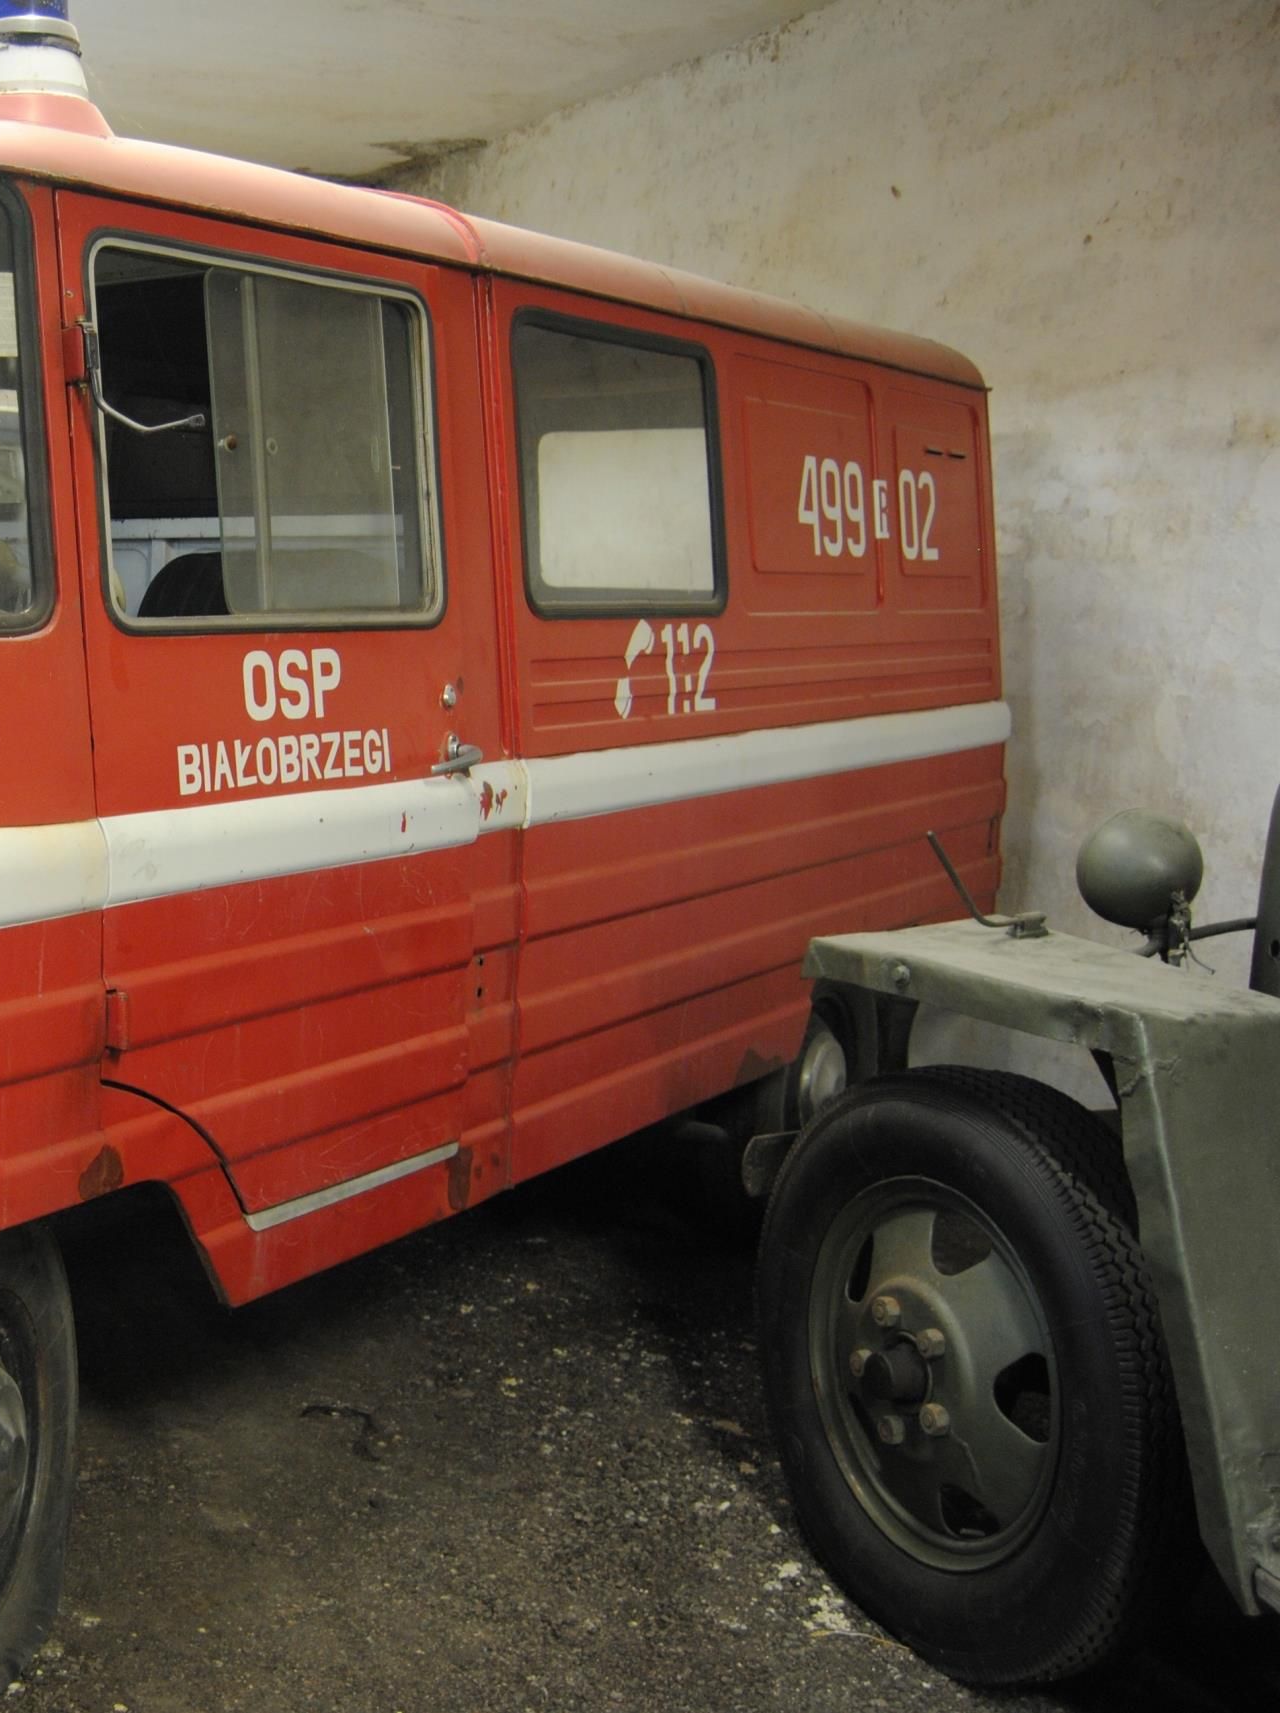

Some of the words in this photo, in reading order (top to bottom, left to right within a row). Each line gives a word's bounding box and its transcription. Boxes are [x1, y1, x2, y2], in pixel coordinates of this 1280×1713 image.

[797, 455, 866, 558] 499
[898, 468, 939, 561] 02
[241, 647, 342, 722] OSP
[661, 622, 716, 716] 112
[176, 728, 391, 796] BIAŁOBRZEGI
